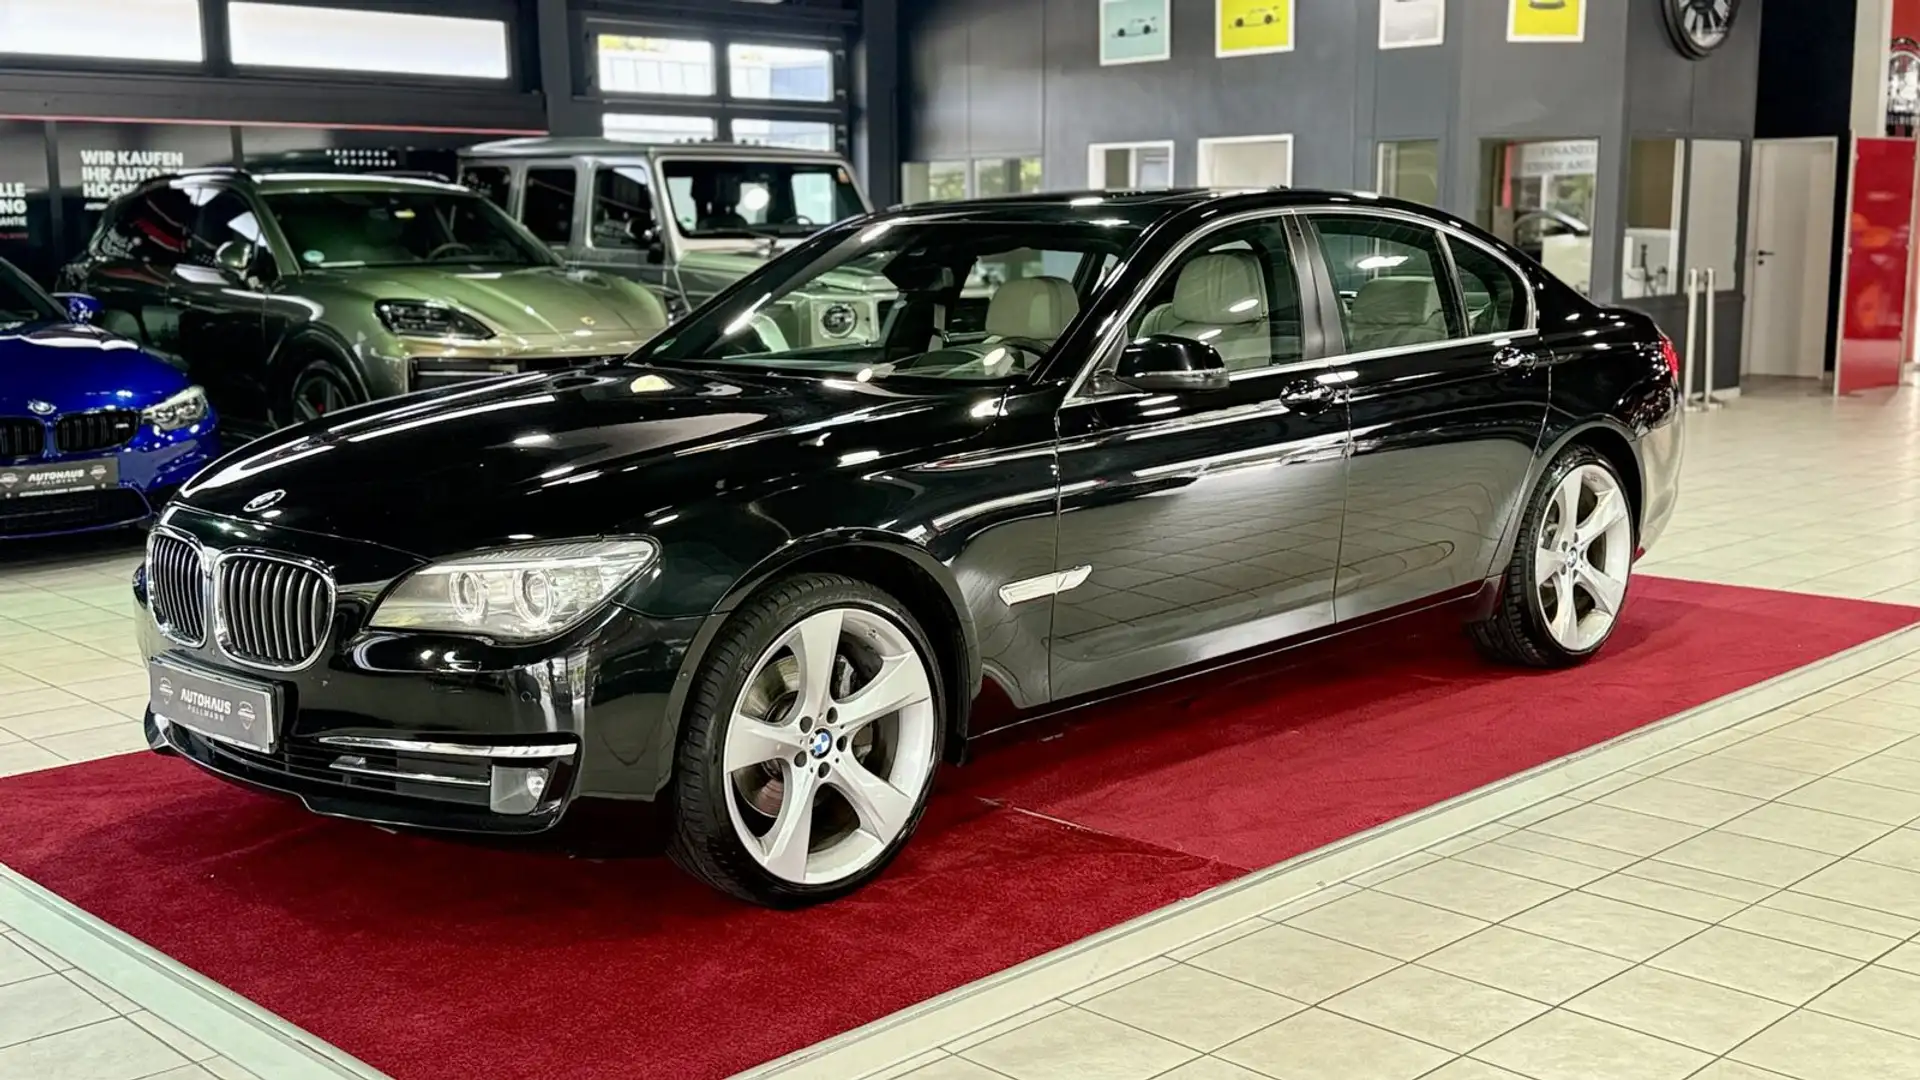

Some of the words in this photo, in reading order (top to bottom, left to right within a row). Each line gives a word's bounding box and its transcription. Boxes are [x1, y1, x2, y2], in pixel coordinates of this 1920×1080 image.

[80, 150, 116, 166] WIR
[117, 150, 184, 166] KAUFEN
[82, 166, 112, 182] IHR
[113, 166, 160, 183] AUTO
[180, 688, 232, 715] AUTOHAUS
